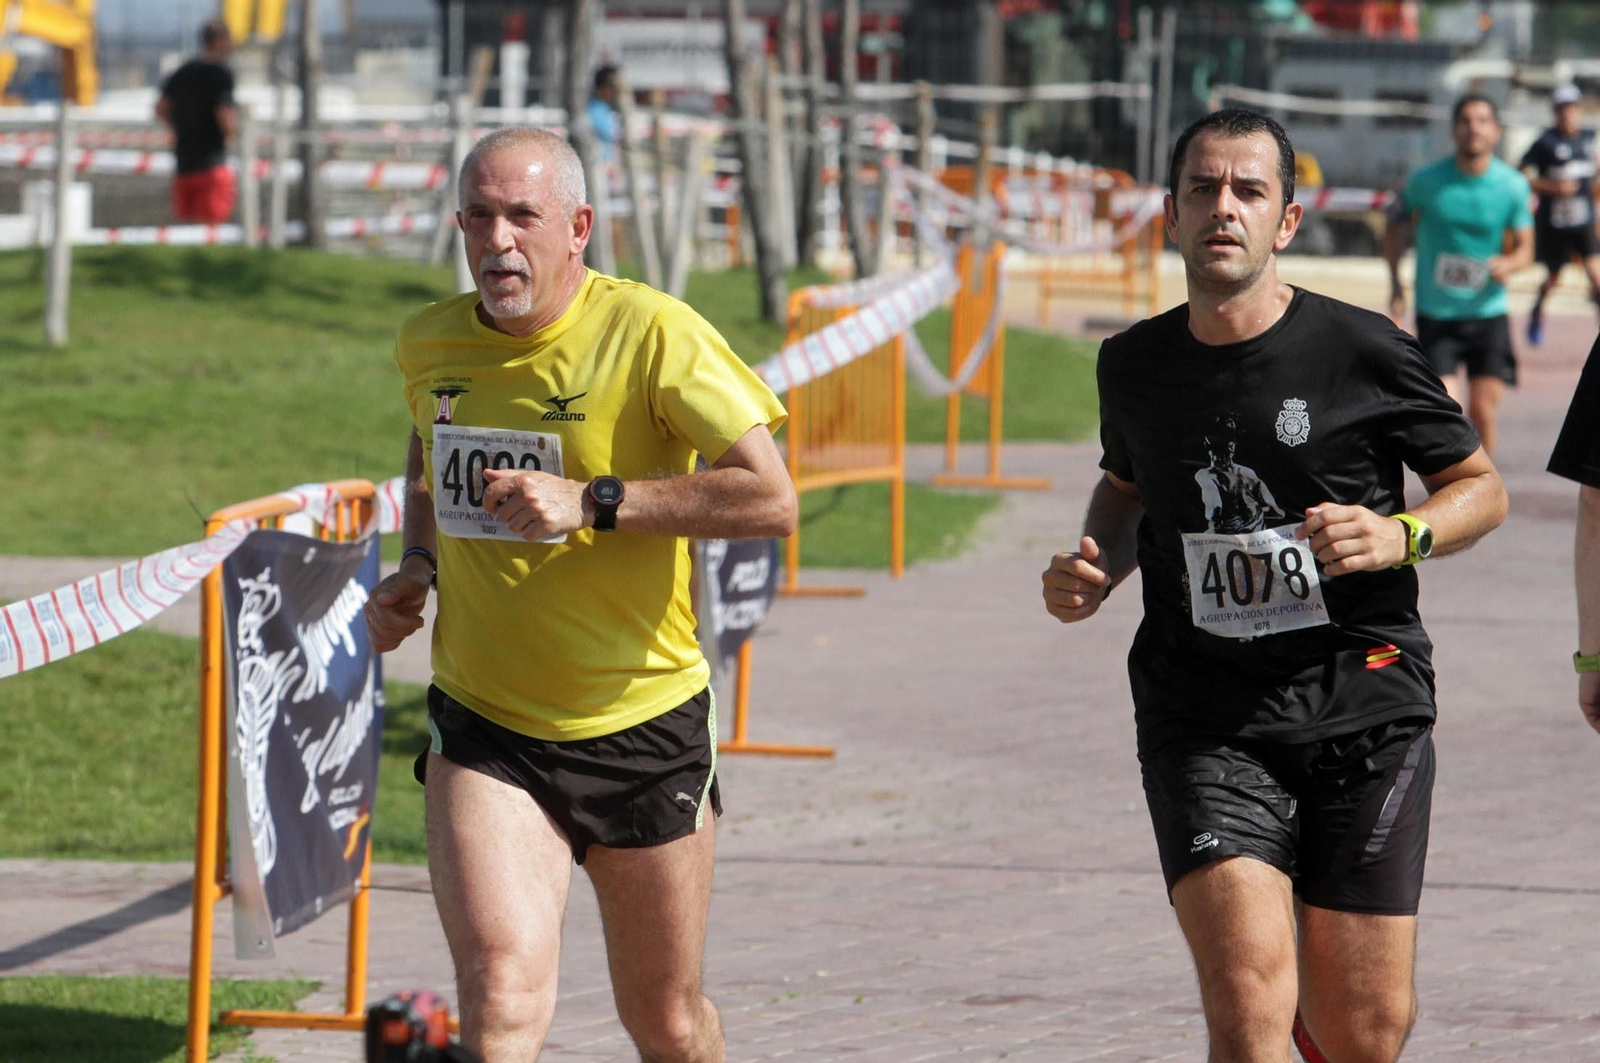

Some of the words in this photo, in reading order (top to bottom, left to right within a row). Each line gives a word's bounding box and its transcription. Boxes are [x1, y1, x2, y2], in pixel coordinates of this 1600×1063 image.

[541, 411, 585, 421] MIZUNO
[438, 510, 493, 521] AGRUPACIÓN
[1257, 539, 1267, 547] LA
[1202, 546, 1310, 608] 4078
[1199, 608, 1264, 624] AGRUPACIÓN
[1265, 602, 1323, 617] DEPORTIVA
[1253, 621, 1271, 631] 4078
